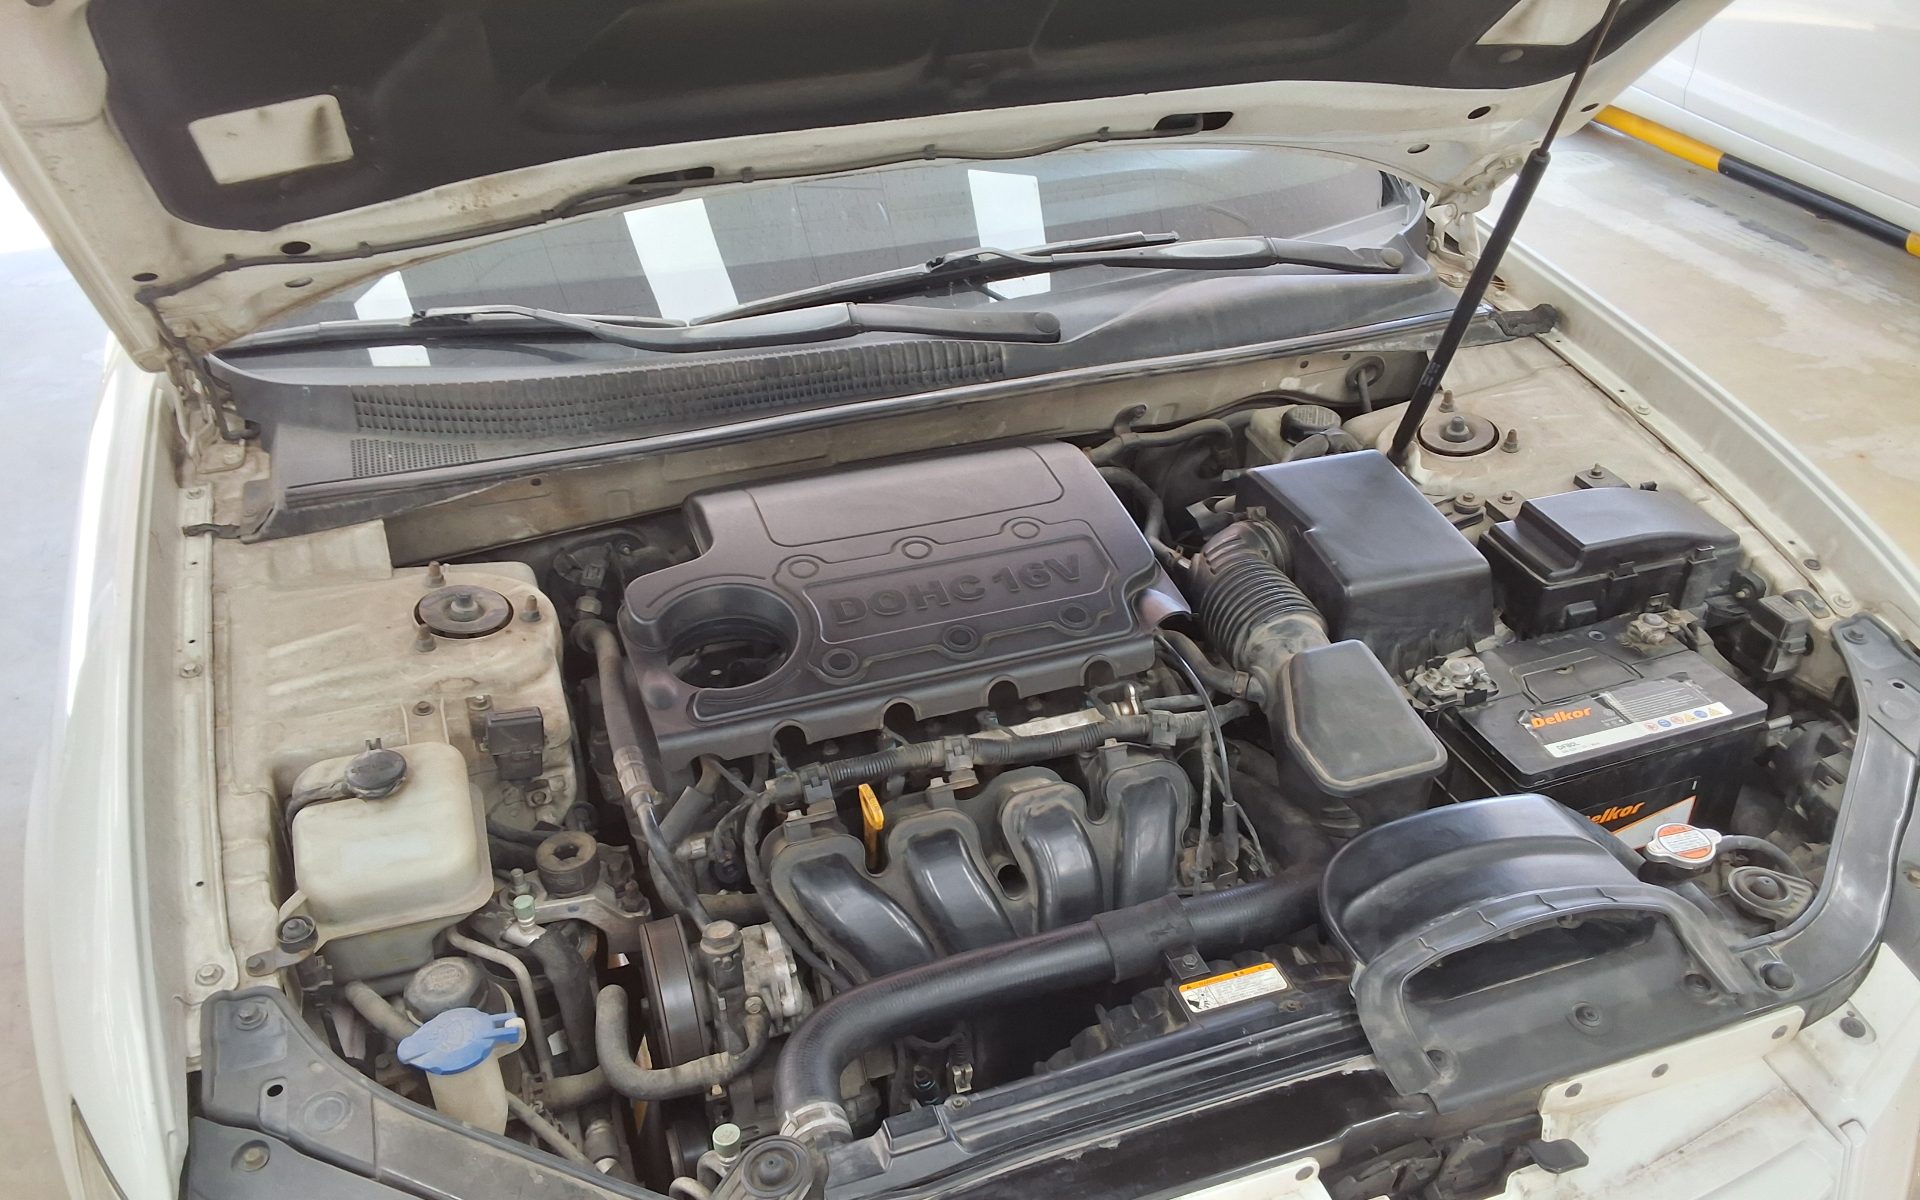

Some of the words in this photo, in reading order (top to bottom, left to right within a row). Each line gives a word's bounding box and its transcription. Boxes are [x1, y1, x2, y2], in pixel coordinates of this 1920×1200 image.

[828, 574, 986, 625] DOHC
[991, 554, 1081, 594] 16V
[1530, 707, 1593, 730] Delkor
[1587, 801, 1646, 825] elkor
